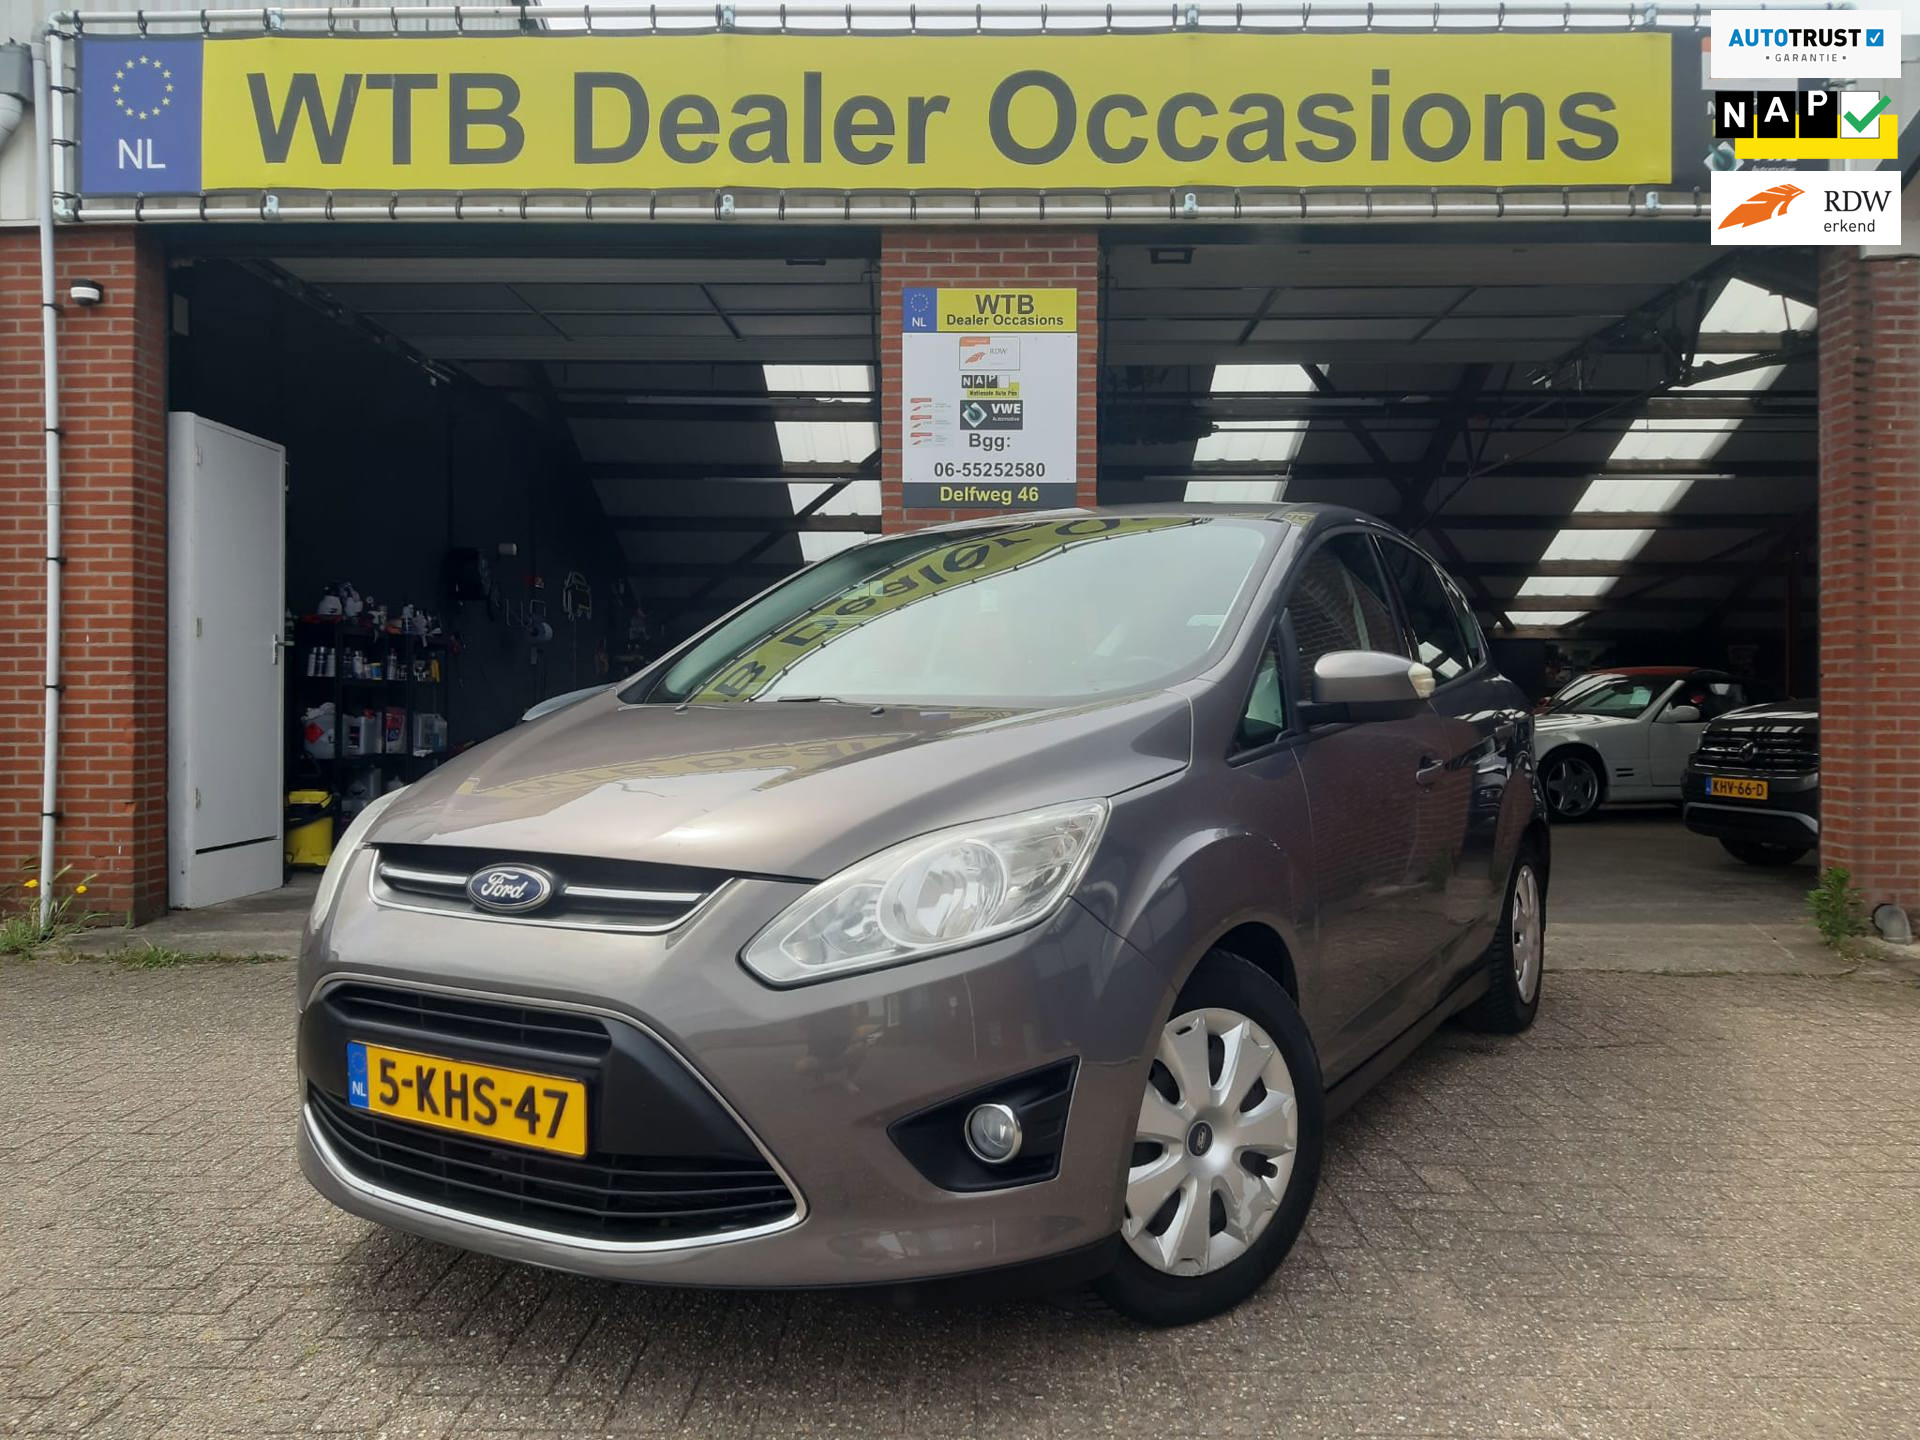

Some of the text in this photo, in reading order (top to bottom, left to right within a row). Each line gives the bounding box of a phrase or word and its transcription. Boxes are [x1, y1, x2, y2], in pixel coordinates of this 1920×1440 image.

[247, 69, 1620, 166] WTB Dealer Occasions
[118, 138, 166, 169] NL
[975, 294, 1034, 315] WTB
[911, 317, 927, 327] NL
[946, 314, 1064, 326] Dealer Occasions
[962, 374, 997, 387] NAP
[991, 403, 1021, 414] VWE
[969, 433, 1011, 451] Bgg:
[934, 462, 1046, 477] 06-55252580
[940, 486, 1039, 504] Delfweg 46
[1713, 781, 1764, 796] KHV-66-D
[481, 872, 525, 899] Ford
[352, 1080, 366, 1097] NL
[379, 1057, 568, 1139] 5-KHS-47
